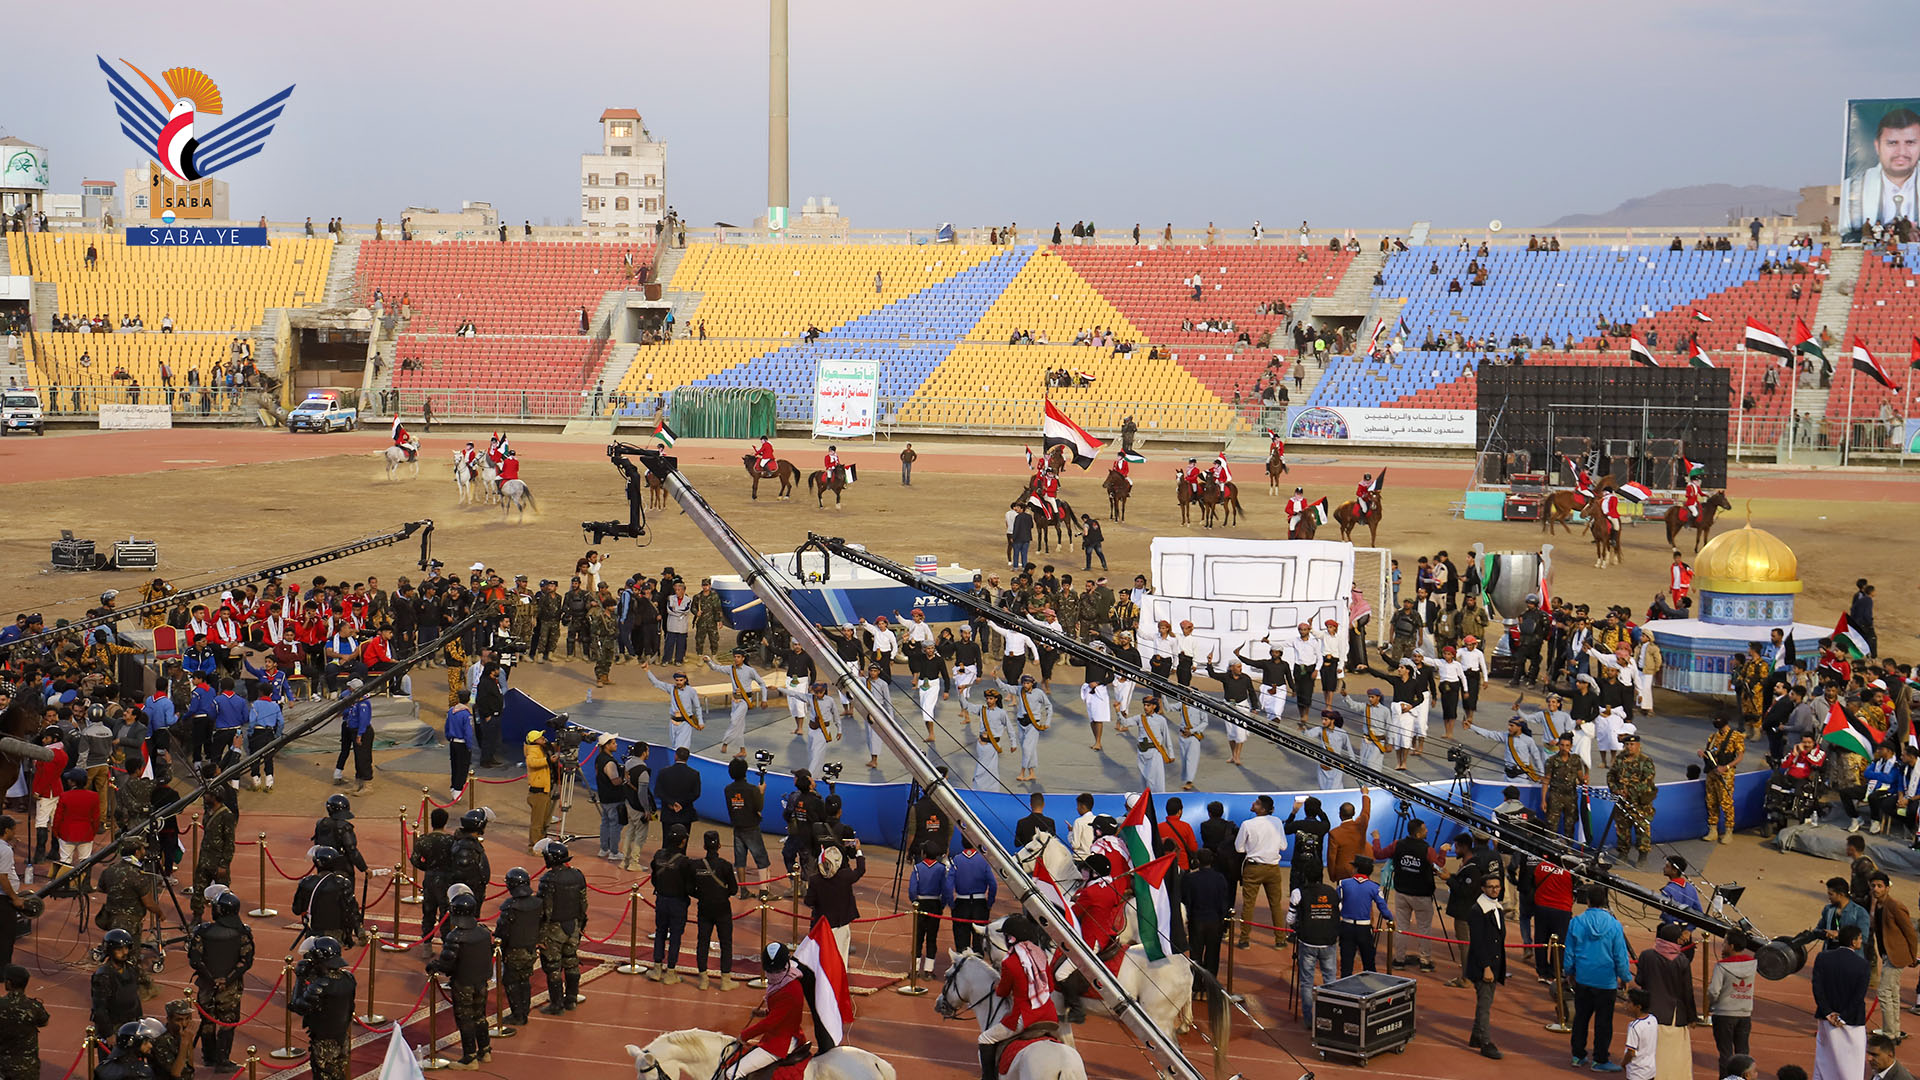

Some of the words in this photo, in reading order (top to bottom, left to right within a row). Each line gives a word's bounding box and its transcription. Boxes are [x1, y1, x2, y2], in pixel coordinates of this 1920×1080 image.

[1364, 412, 1411, 422] والرياضيين
[1412, 413, 1446, 421] الشباب
[1364, 425, 1389, 433] فلسطين
[1392, 427, 1405, 435] في
[1408, 426, 1432, 434] للجهاد
[1434, 427, 1464, 435] مستعدون
[1540, 865, 1564, 875] YEMEN
